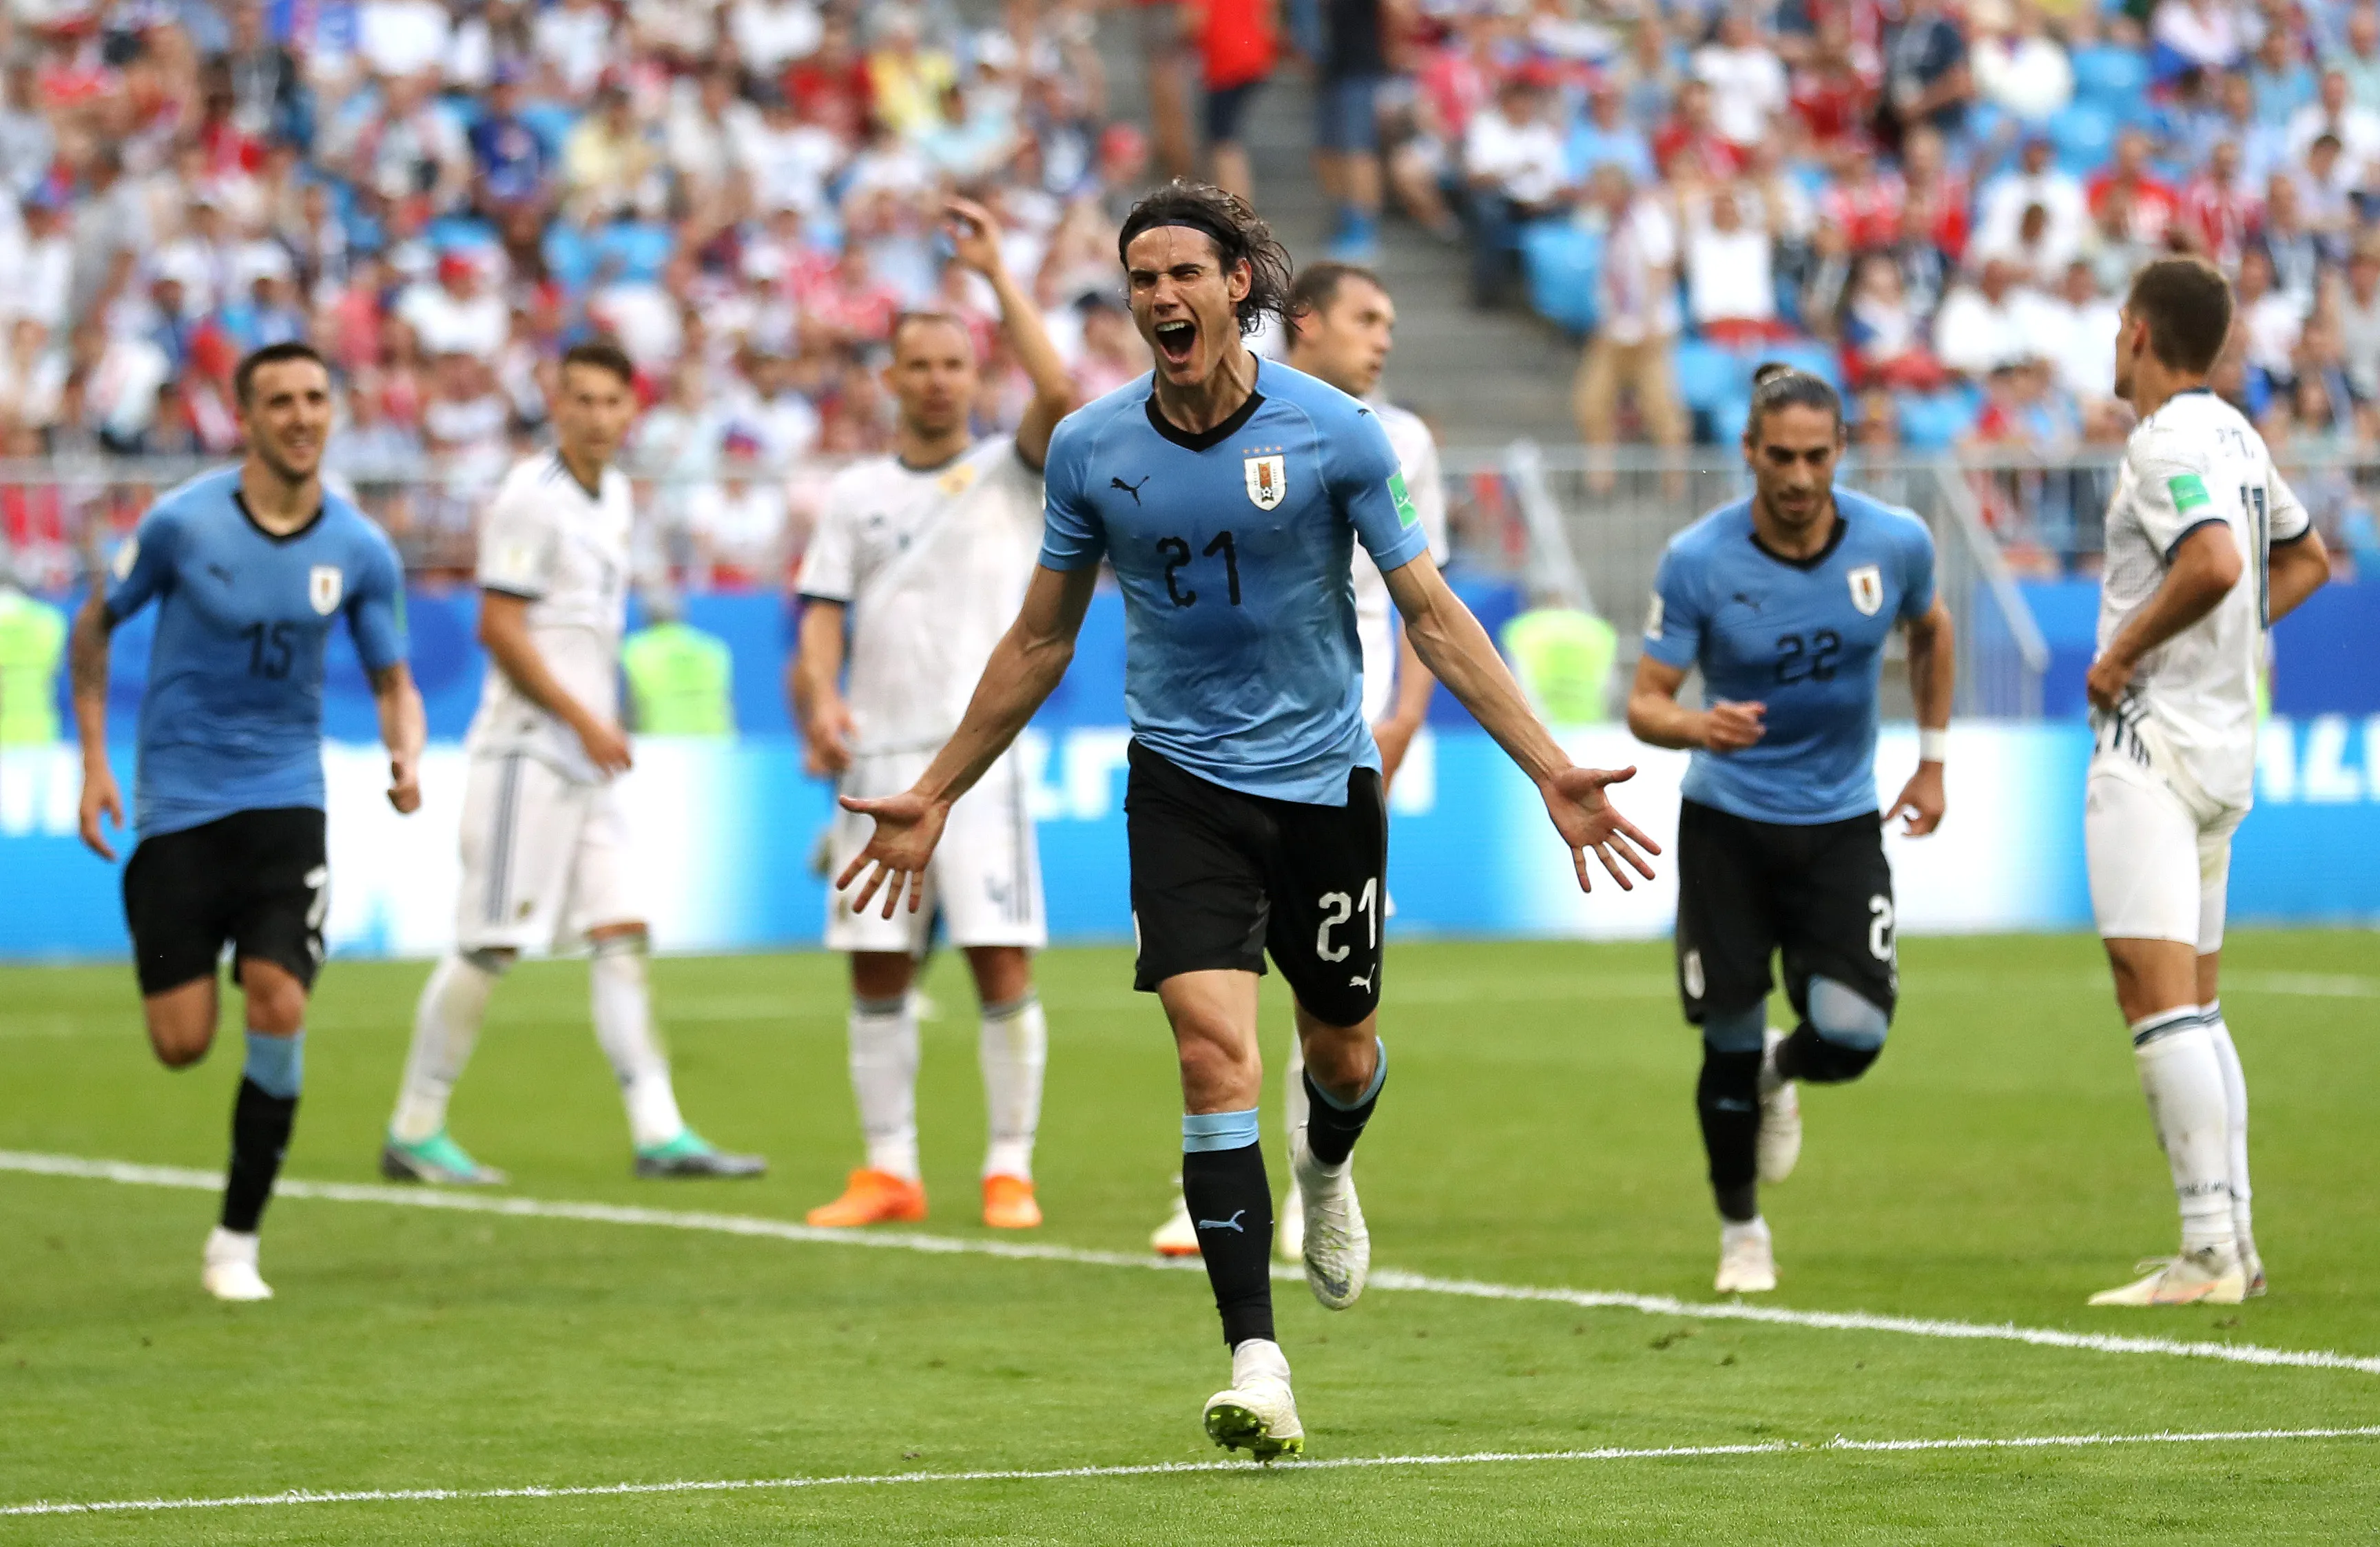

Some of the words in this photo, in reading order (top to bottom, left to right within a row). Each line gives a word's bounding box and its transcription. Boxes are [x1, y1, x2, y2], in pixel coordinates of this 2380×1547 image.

[1157, 530, 1241, 607] 21
[240, 621, 295, 680] 15
[1777, 628, 1841, 685] 22
[1316, 878, 1377, 962] 21
